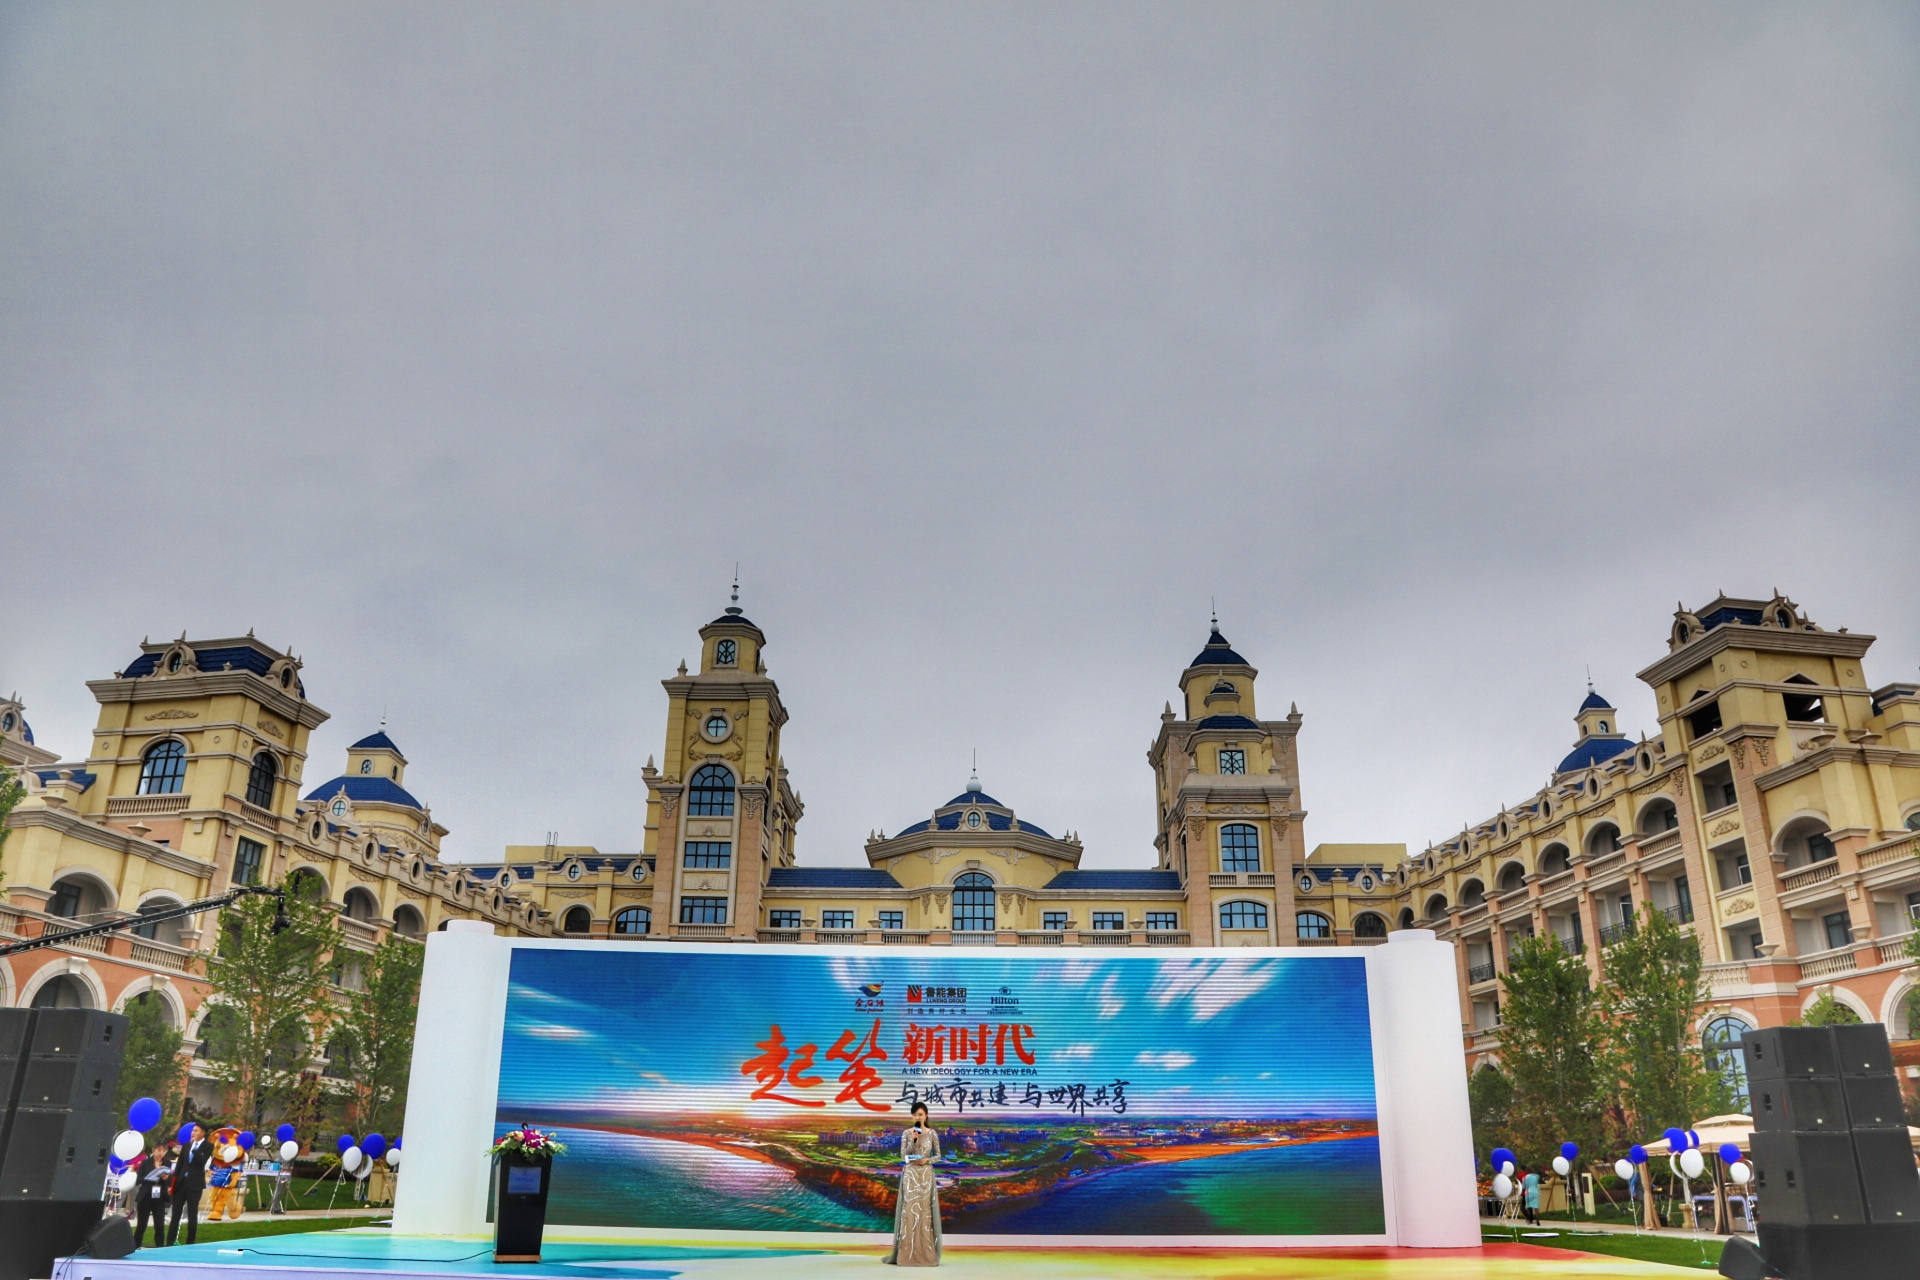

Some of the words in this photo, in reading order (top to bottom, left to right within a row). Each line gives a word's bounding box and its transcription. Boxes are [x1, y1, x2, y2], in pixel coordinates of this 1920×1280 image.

[926, 987, 967, 998] 鲁能集团
[990, 996, 1020, 1005] Hilton
[901, 1022, 1036, 1066] 新时代
[901, 1067, 908, 1075] A
[909, 1067, 929, 1075] NEW
[930, 1067, 972, 1076] IDEOLOGY
[973, 1068, 990, 1076] FOR
[992, 1068, 999, 1076] A
[1000, 1068, 1020, 1076] NEW
[1021, 1068, 1038, 1076] ERA
[895, 1077, 1010, 1113] 与城市共建
[1019, 1078, 1131, 1117] 与世界共享
